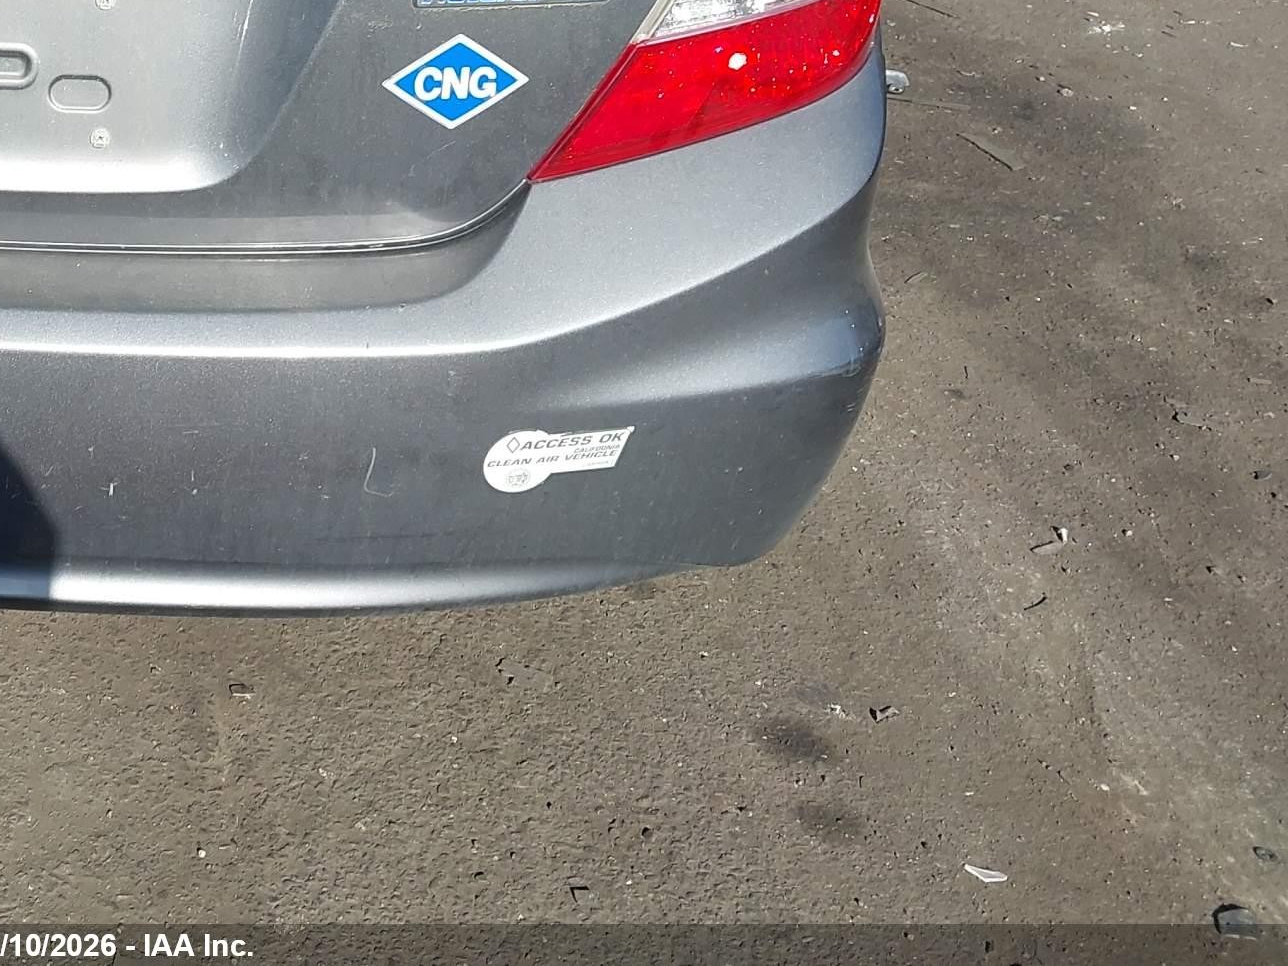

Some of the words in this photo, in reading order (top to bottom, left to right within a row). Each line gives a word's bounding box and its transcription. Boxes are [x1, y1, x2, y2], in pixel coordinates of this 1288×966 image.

[414, 66, 497, 101] CNG
[520, 435, 593, 451] ACCESS
[599, 432, 624, 443] OK
[487, 458, 532, 468] CLEAN
[536, 455, 560, 464] AIR
[565, 449, 619, 461] VEHICLE
